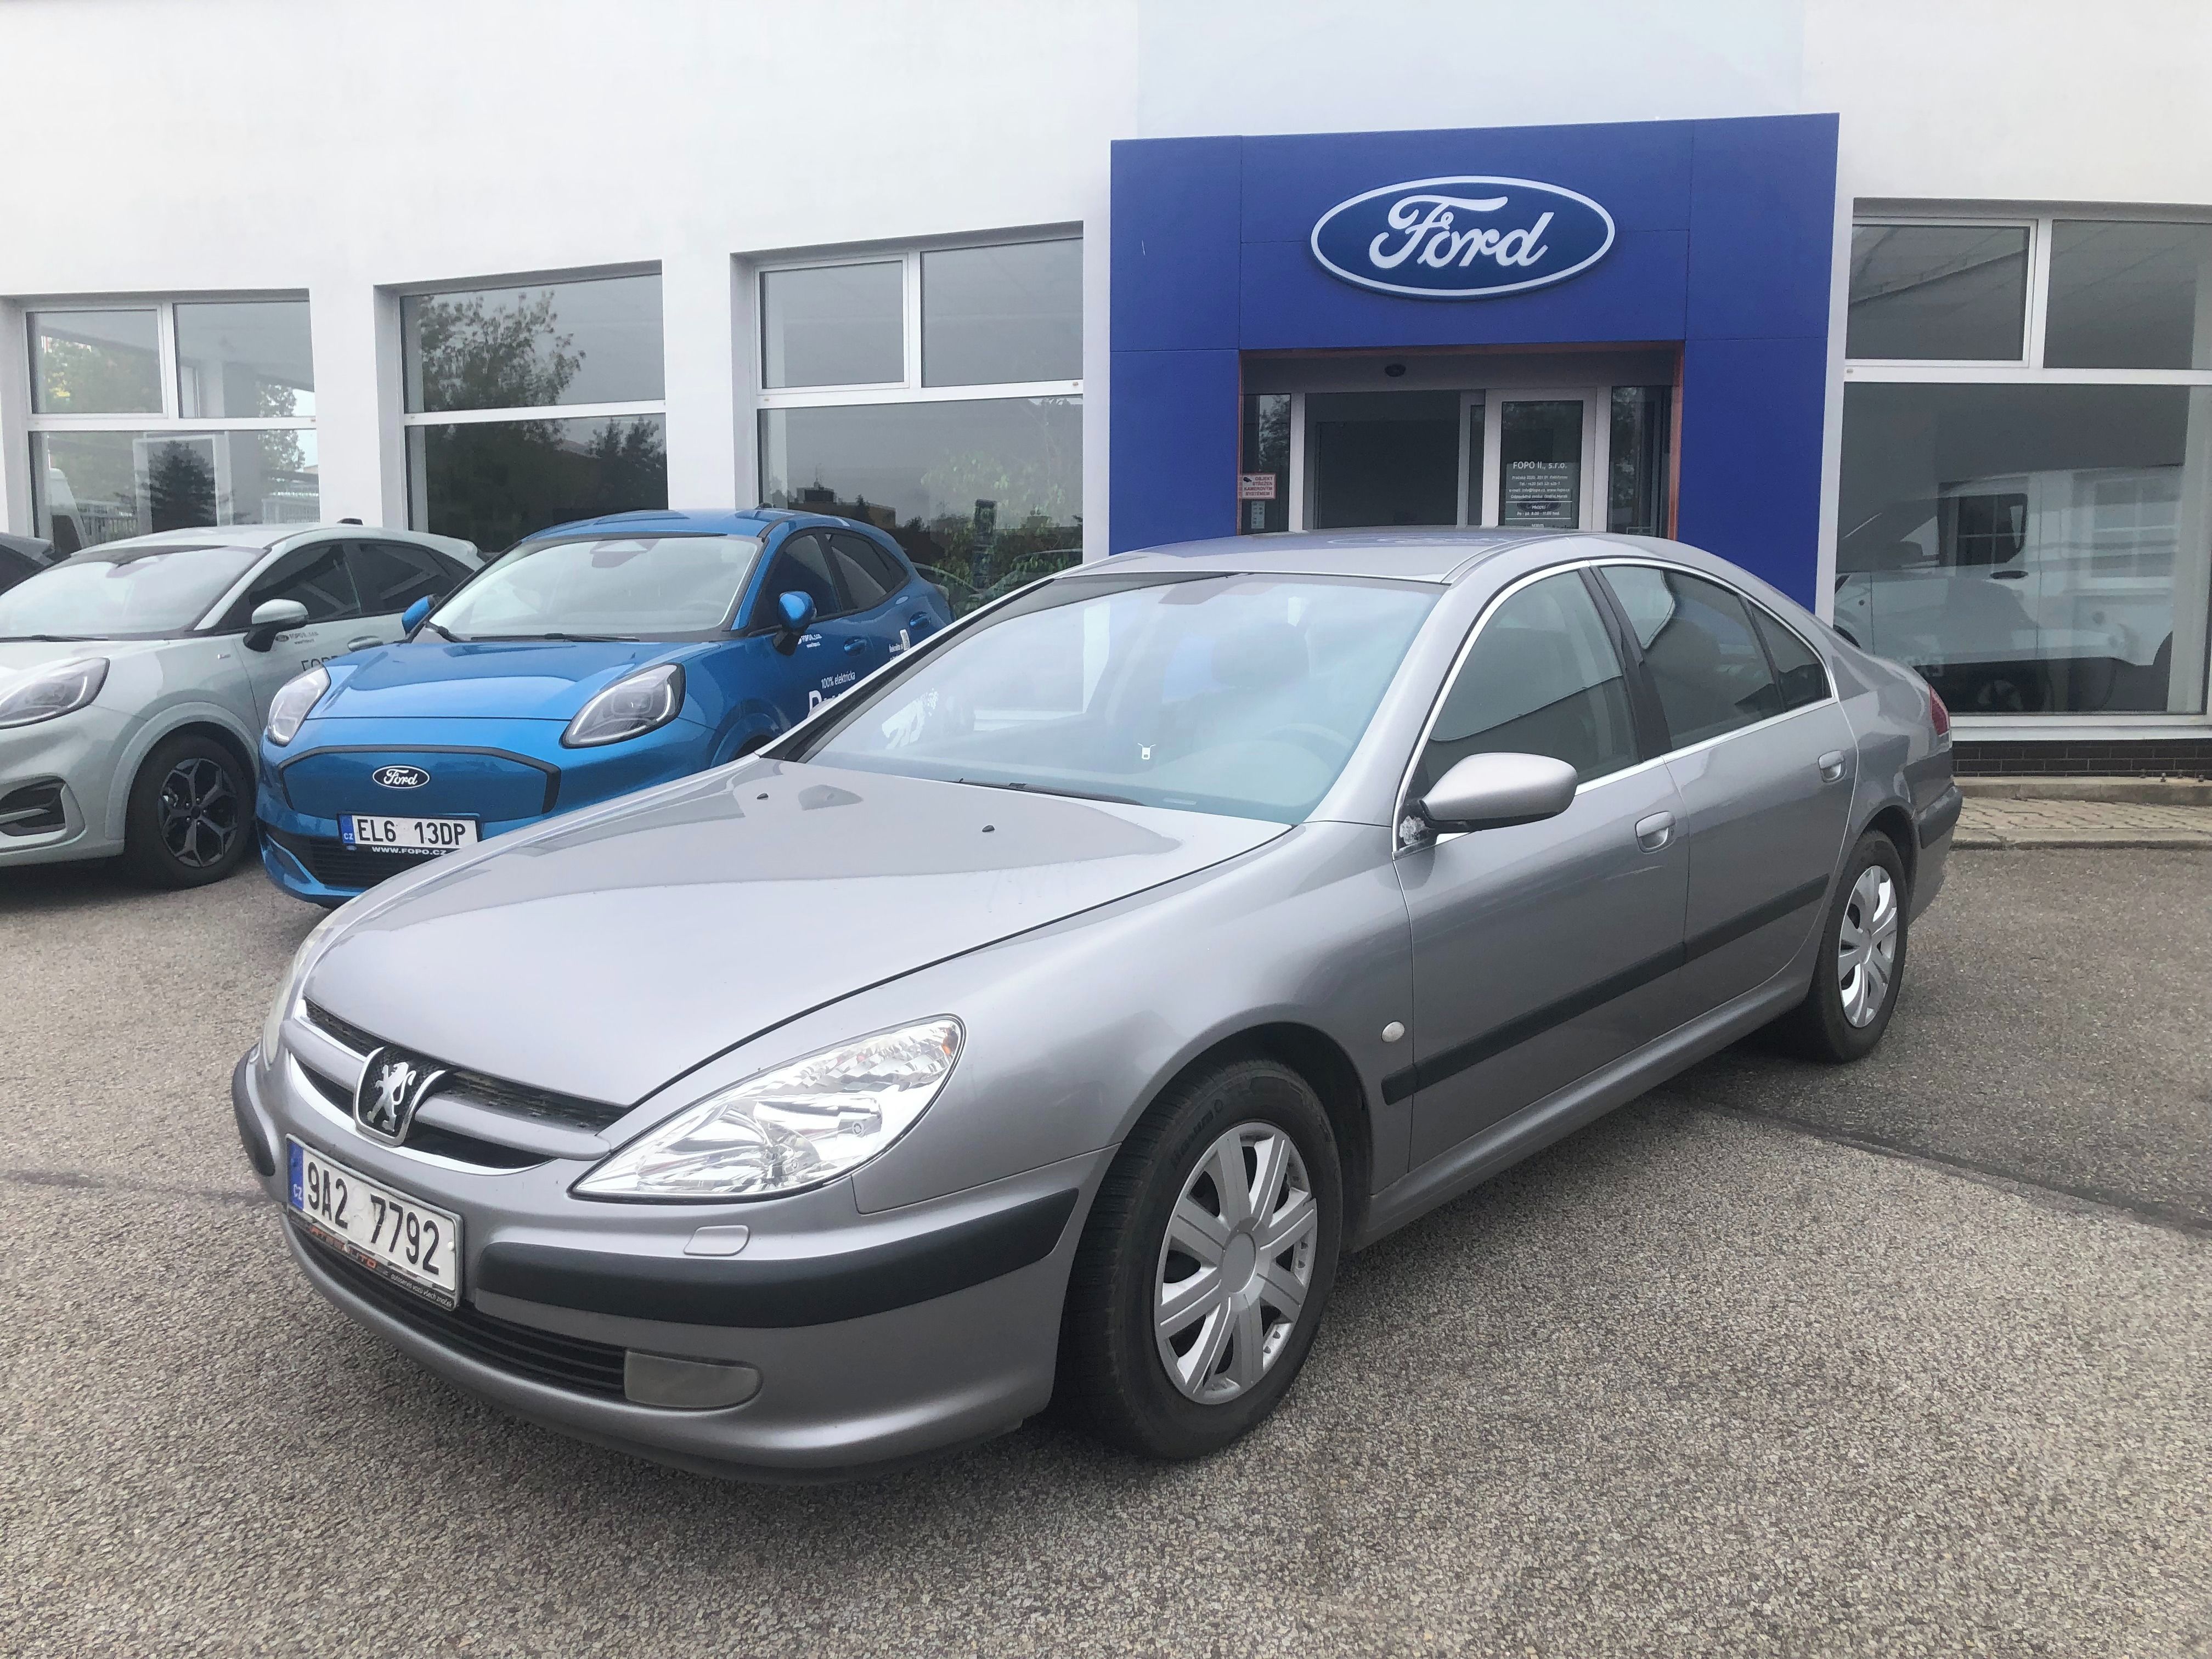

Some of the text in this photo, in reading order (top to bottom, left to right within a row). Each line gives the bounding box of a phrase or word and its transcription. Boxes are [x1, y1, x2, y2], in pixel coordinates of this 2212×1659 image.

[1369, 194, 1555, 269] Ford
[1513, 461, 1535, 469] FOPO
[821, 675, 834, 689] 100%
[383, 768, 418, 786] Ford
[343, 832, 354, 840] CZ
[357, 819, 466, 845] EL6 13DP
[371, 846, 447, 856] WWW.FOPO.CZ
[293, 1183, 302, 1200] CZ
[307, 1161, 439, 1276] 9A2 7792
